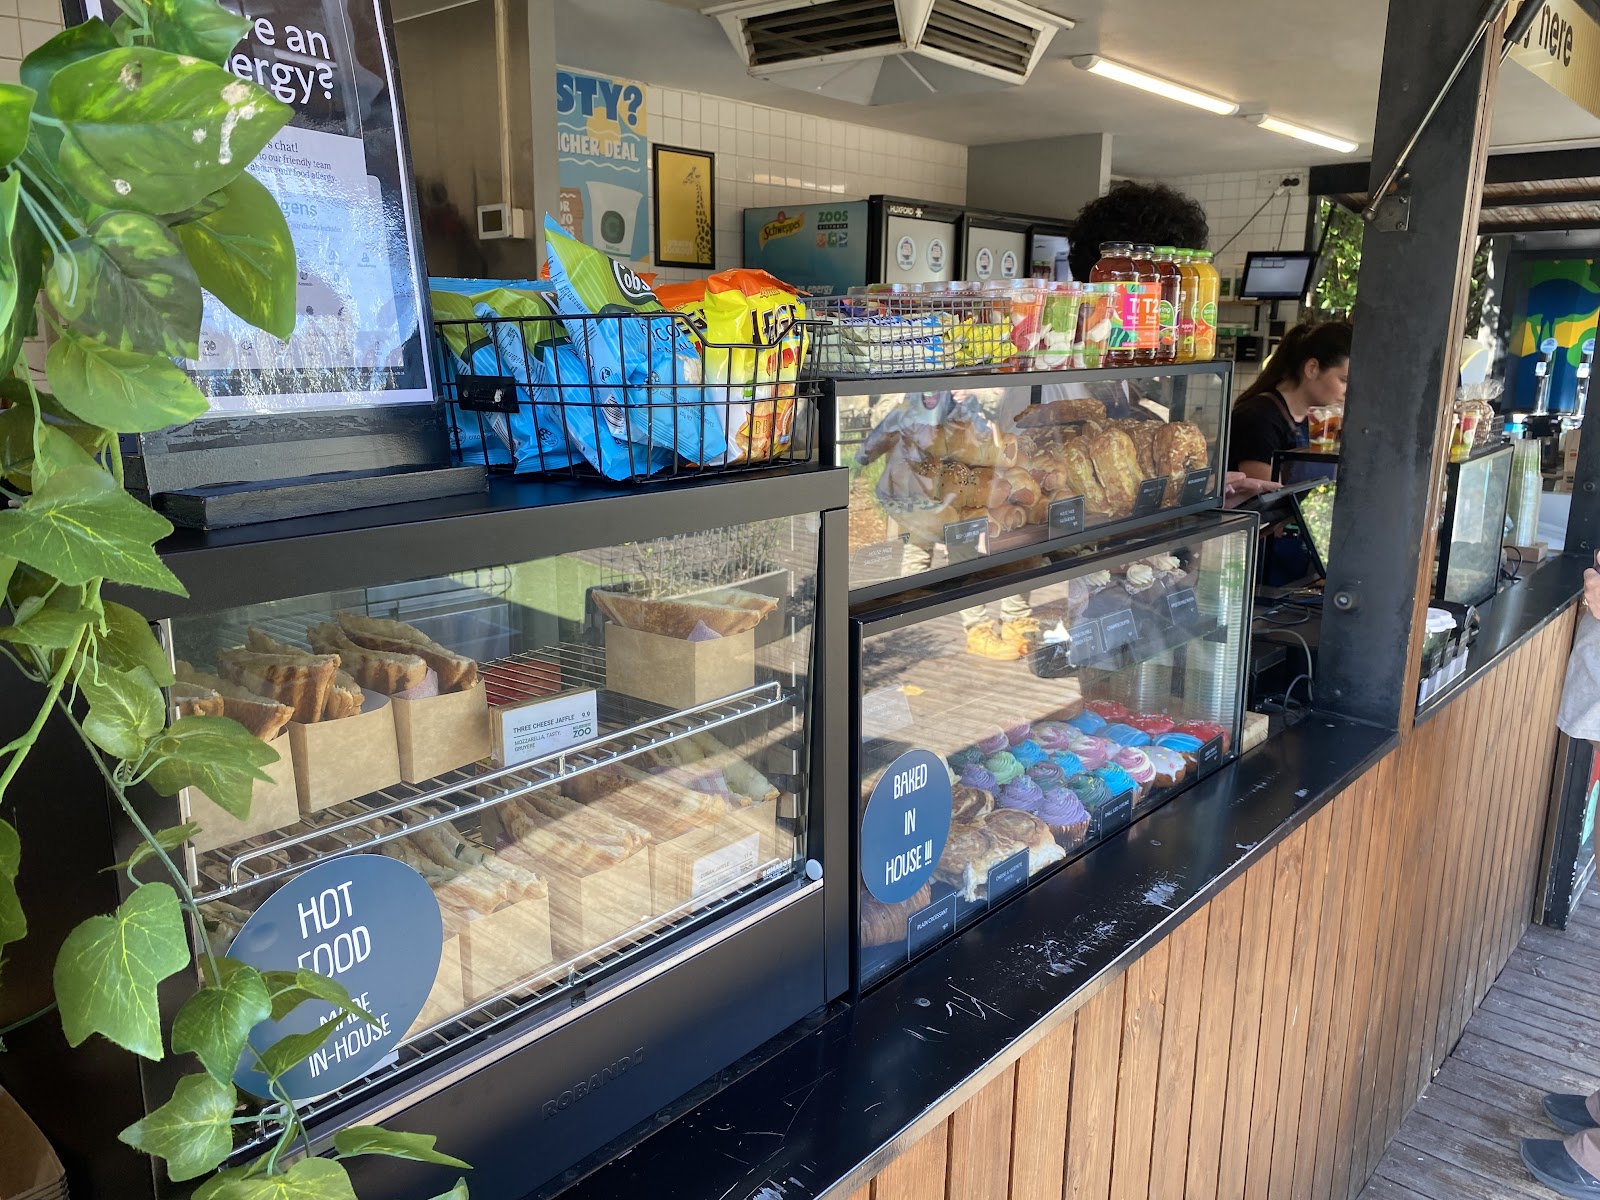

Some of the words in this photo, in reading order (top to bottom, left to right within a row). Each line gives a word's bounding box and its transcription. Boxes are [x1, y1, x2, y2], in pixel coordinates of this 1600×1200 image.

[243, 14, 276, 46] e
[284, 25, 330, 60] an
[223, 53, 334, 105] ergy?
[275, 140, 298, 153] chat!
[605, 139, 639, 162] DEAL
[268, 154, 282, 163] our
[283, 154, 311, 169] friendly
[313, 160, 332, 171] team
[281, 201, 317, 218] gens
[818, 211, 848, 222] ZOOS
[764, 220, 800, 240] Schweppes
[1142, 298, 1159, 314] T2
[755, 420, 768, 435] BB
[513, 724, 532, 734] THREE
[533, 718, 554, 730] CHEESE
[555, 714, 575, 724] JAFFLE
[573, 727, 592, 739] ZOO
[893, 763, 928, 800] BAKED
[904, 807, 916, 836] IN
[885, 844, 922, 886] HOUSE
[297, 880, 353, 940] HOT
[916, 919, 929, 931] PLAIN
[297, 925, 372, 979] FOOD
[308, 1012, 392, 1079] IN-HOUSE
